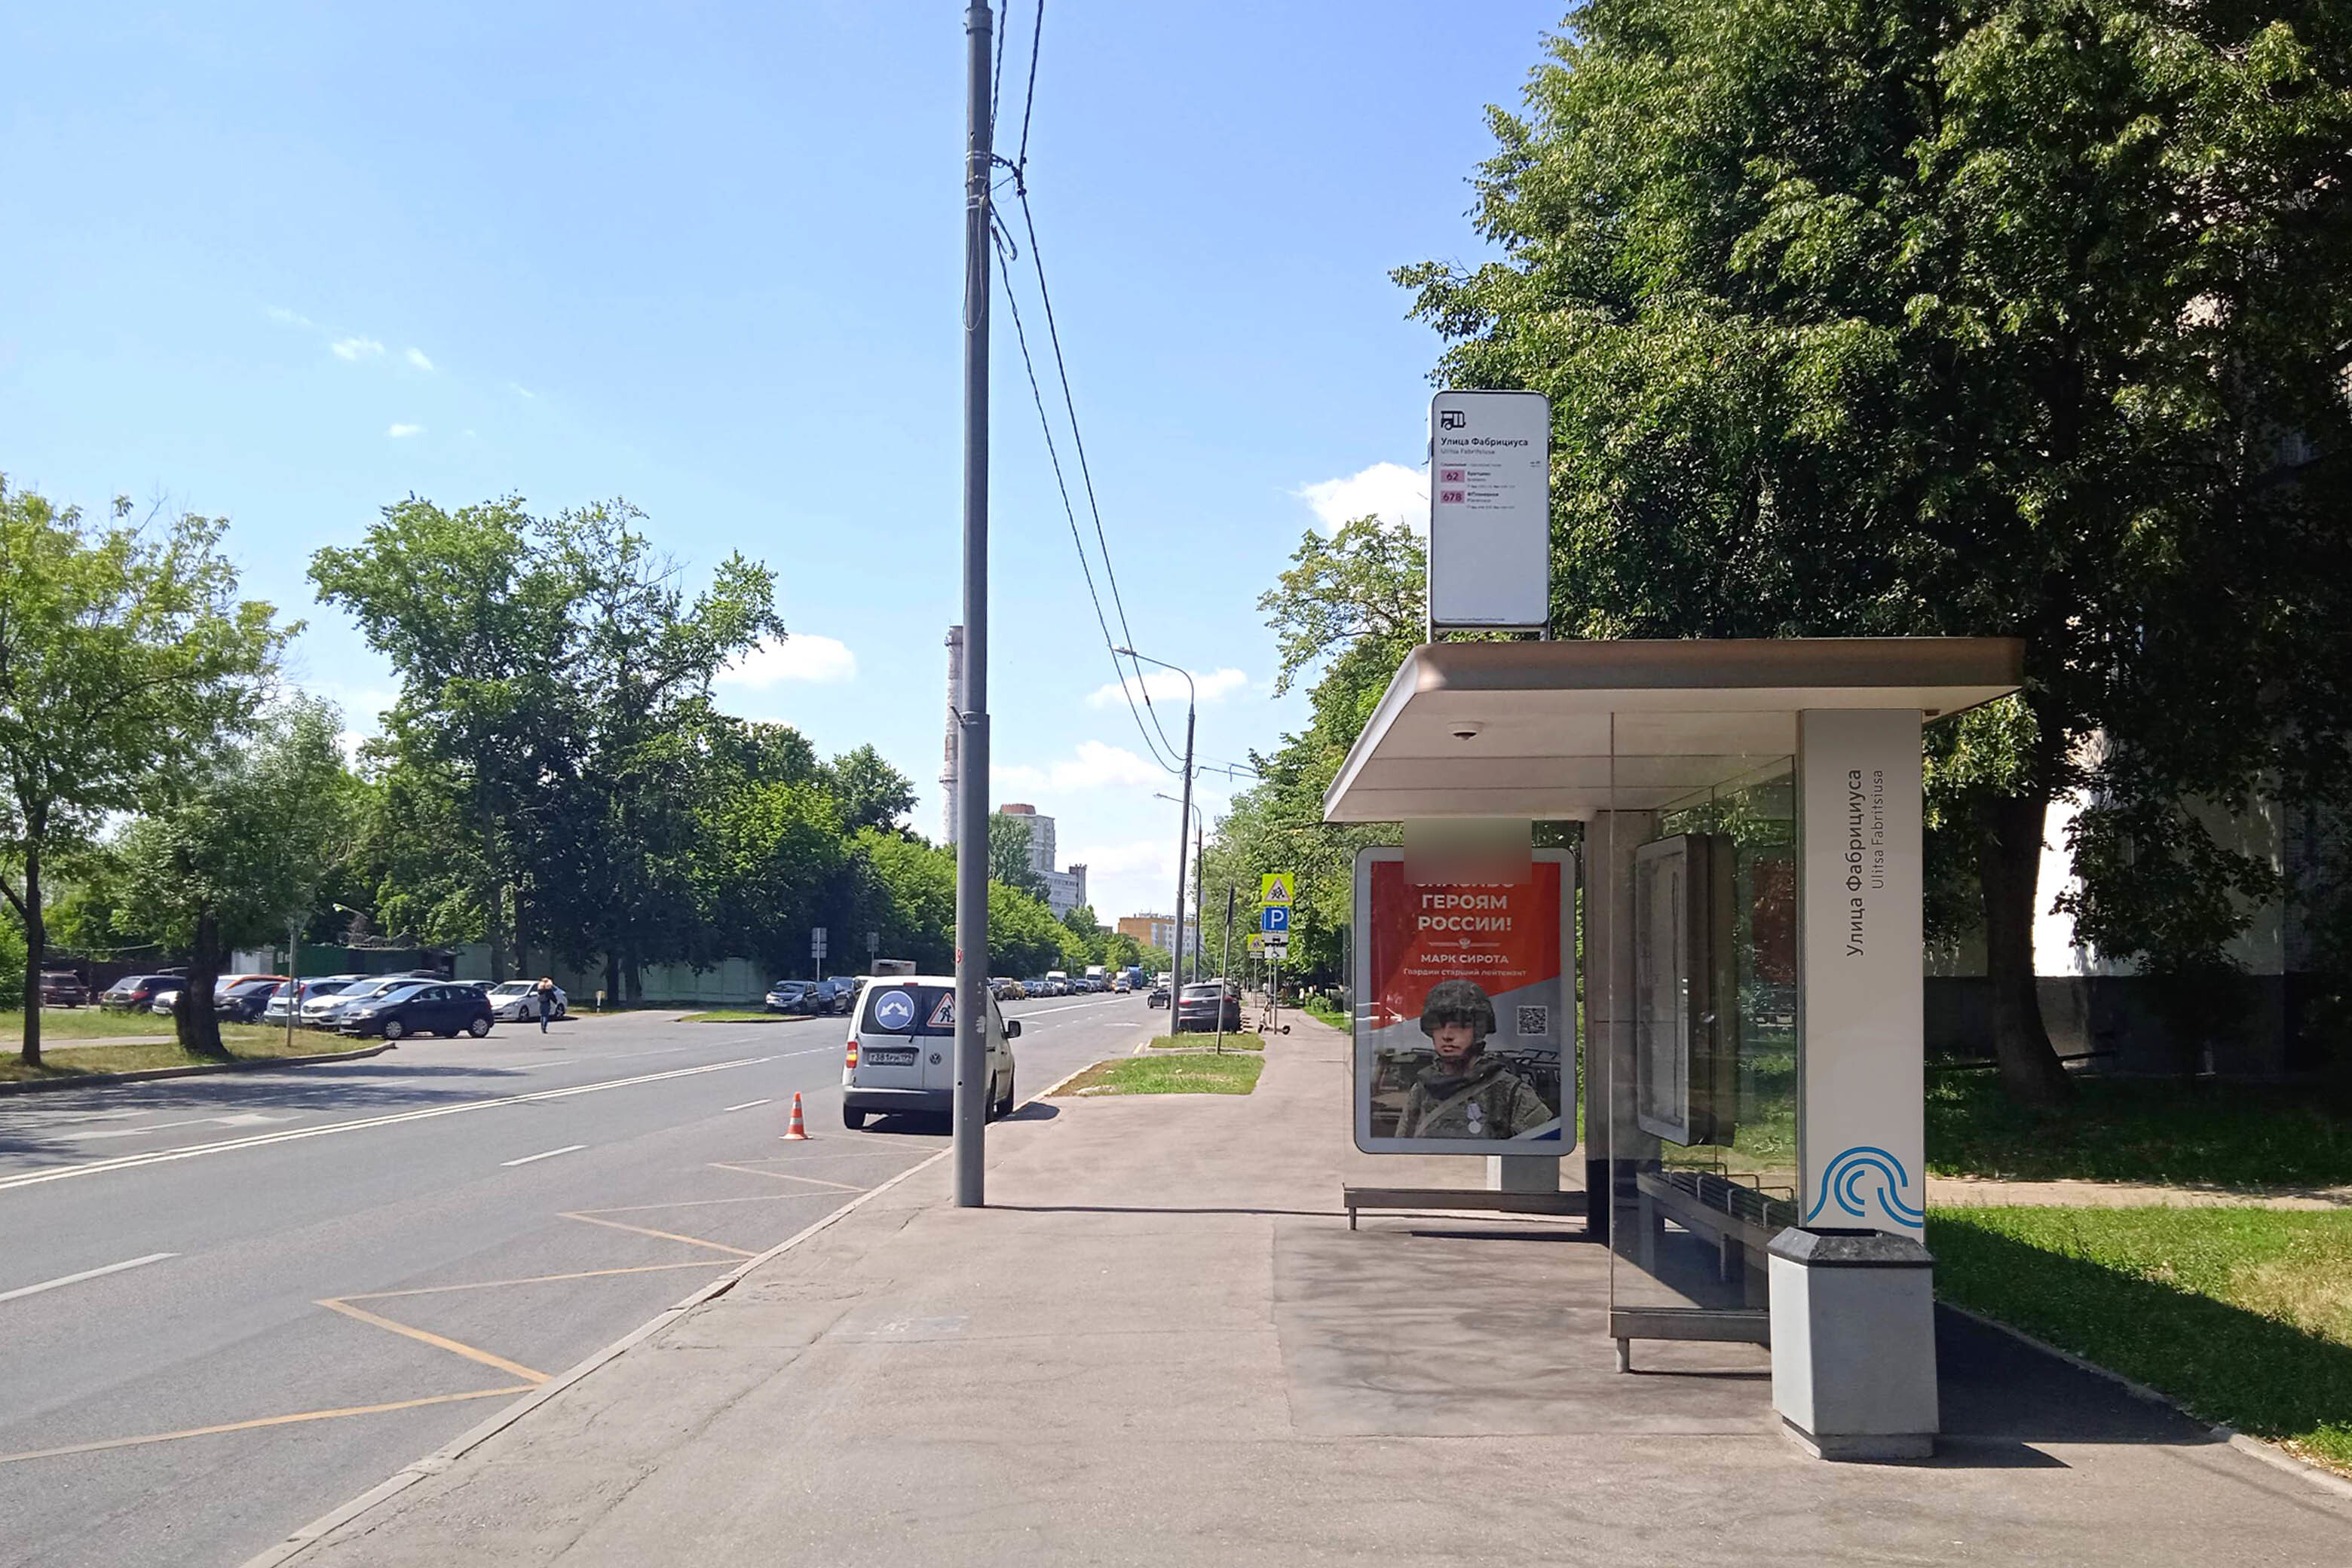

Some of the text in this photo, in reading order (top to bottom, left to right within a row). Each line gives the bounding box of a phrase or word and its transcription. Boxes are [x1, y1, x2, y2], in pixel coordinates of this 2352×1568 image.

[1441, 437, 1529, 447] Улица Фабрициуса
[1447, 472, 1459, 481] 62
[1443, 492, 1462, 501] 678
[1870, 770, 1884, 890] Ulitsa Fabritsiusa
[1845, 769, 1866, 957] Улица Фабрициуса
[1422, 894, 1508, 909] ГЕРОЯМ
[1418, 916, 1512, 931] РОССИИ!
[1420, 954, 1508, 964] МАРК СИРОТА
[1441, 969, 1480, 977] старший
